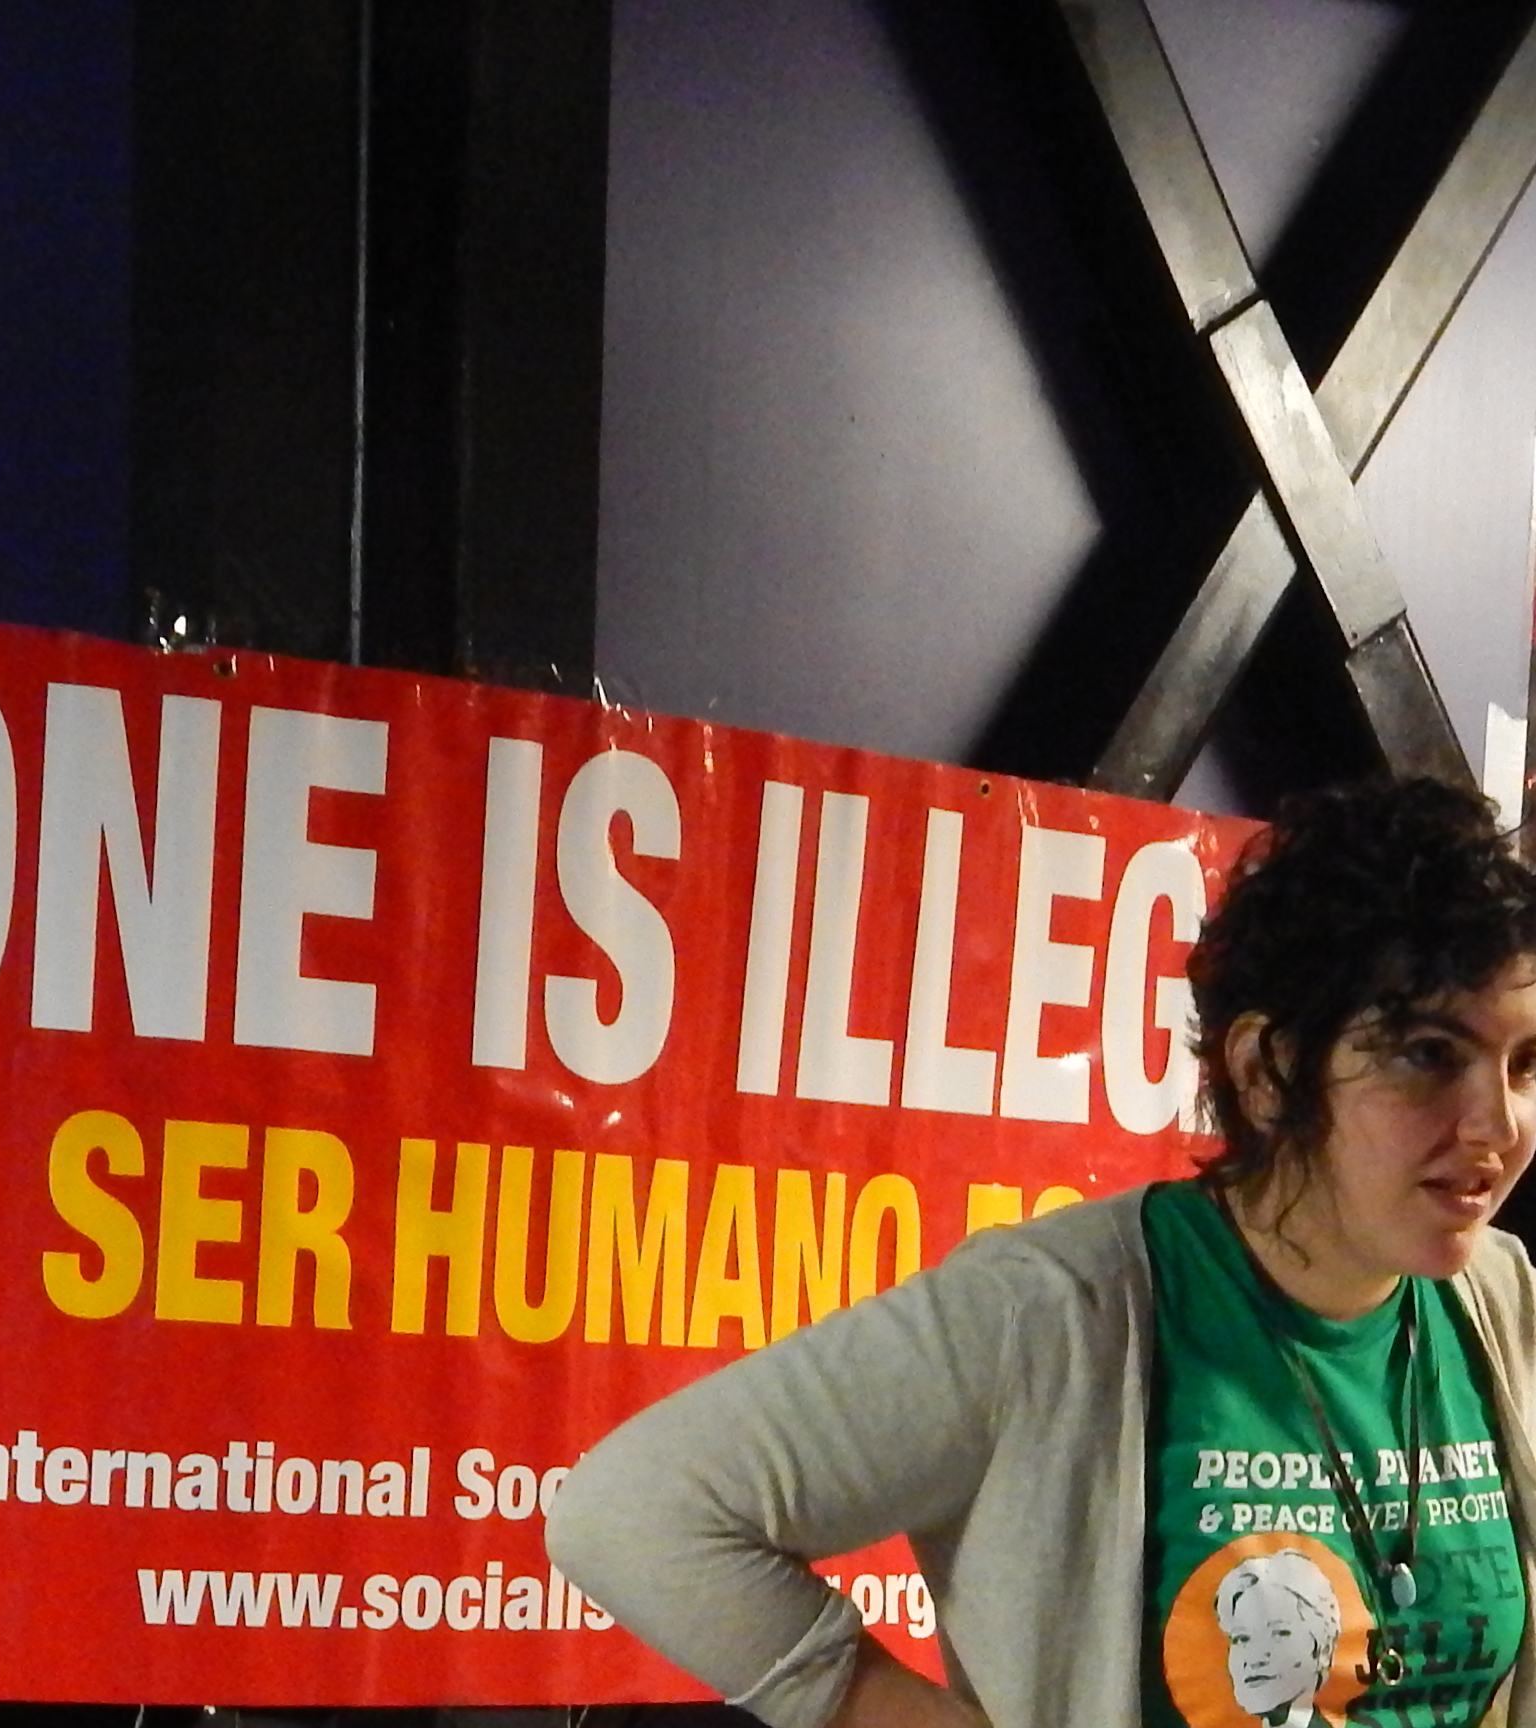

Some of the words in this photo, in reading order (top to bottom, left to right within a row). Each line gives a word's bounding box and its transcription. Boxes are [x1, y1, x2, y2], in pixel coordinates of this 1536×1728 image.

[472, 737, 682, 1086] IS
[736, 780, 1221, 1136] ILLEG
[42, 1110, 354, 1331] SER
[390, 1139, 923, 1351] HUMANO
[1198, 1503, 1224, 1534] &
[1232, 1503, 1335, 1534] PEACE
[1426, 1489, 1510, 1527] PROFIT
